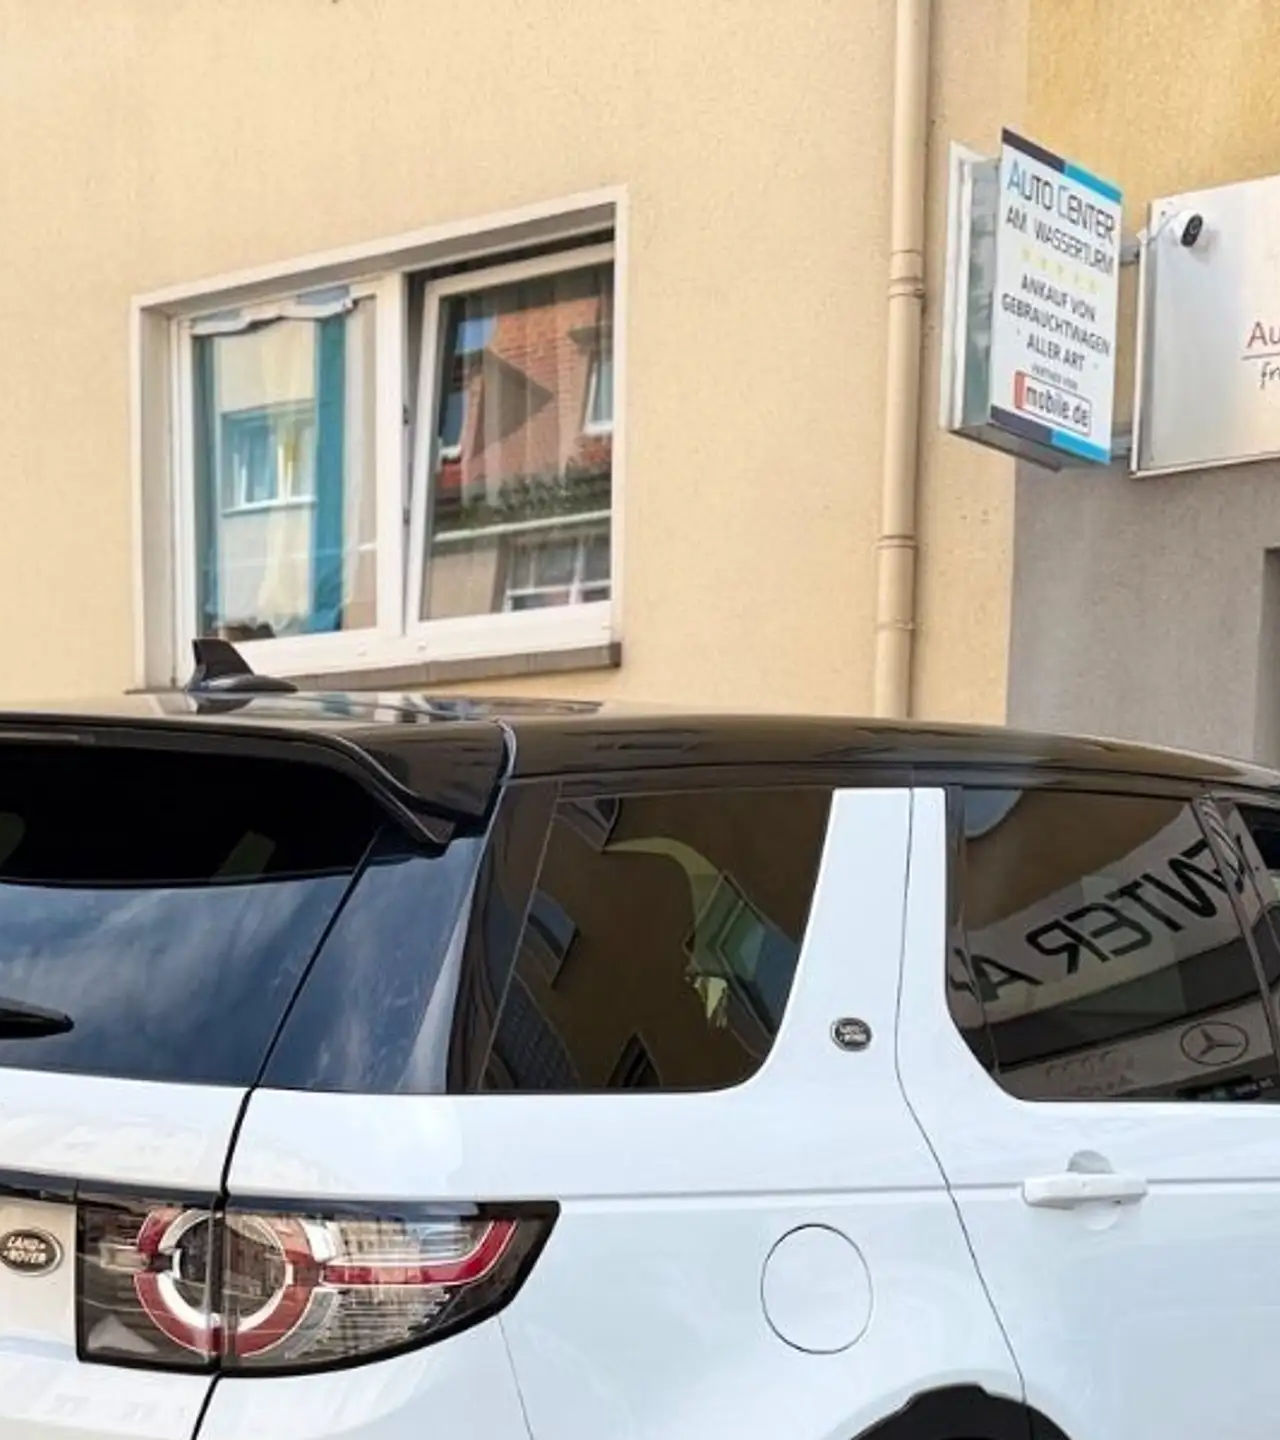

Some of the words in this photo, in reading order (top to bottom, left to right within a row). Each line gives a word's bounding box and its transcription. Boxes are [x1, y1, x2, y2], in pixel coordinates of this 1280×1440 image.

[1007, 159, 1054, 211] AUTO
[1057, 185, 1114, 245] CENTER
[1005, 205, 1028, 232] AM
[1034, 218, 1114, 276] WASSERTURM
[1001, 292, 1111, 356] GEBRAUCHTWAGEN
[1021, 273, 1068, 308] ANKAUF
[1070, 298, 1096, 322] VON
[1026, 332, 1061, 363] ALLER
[1063, 350, 1086, 371] ART
[1026, 385, 1089, 428] mobile.de
